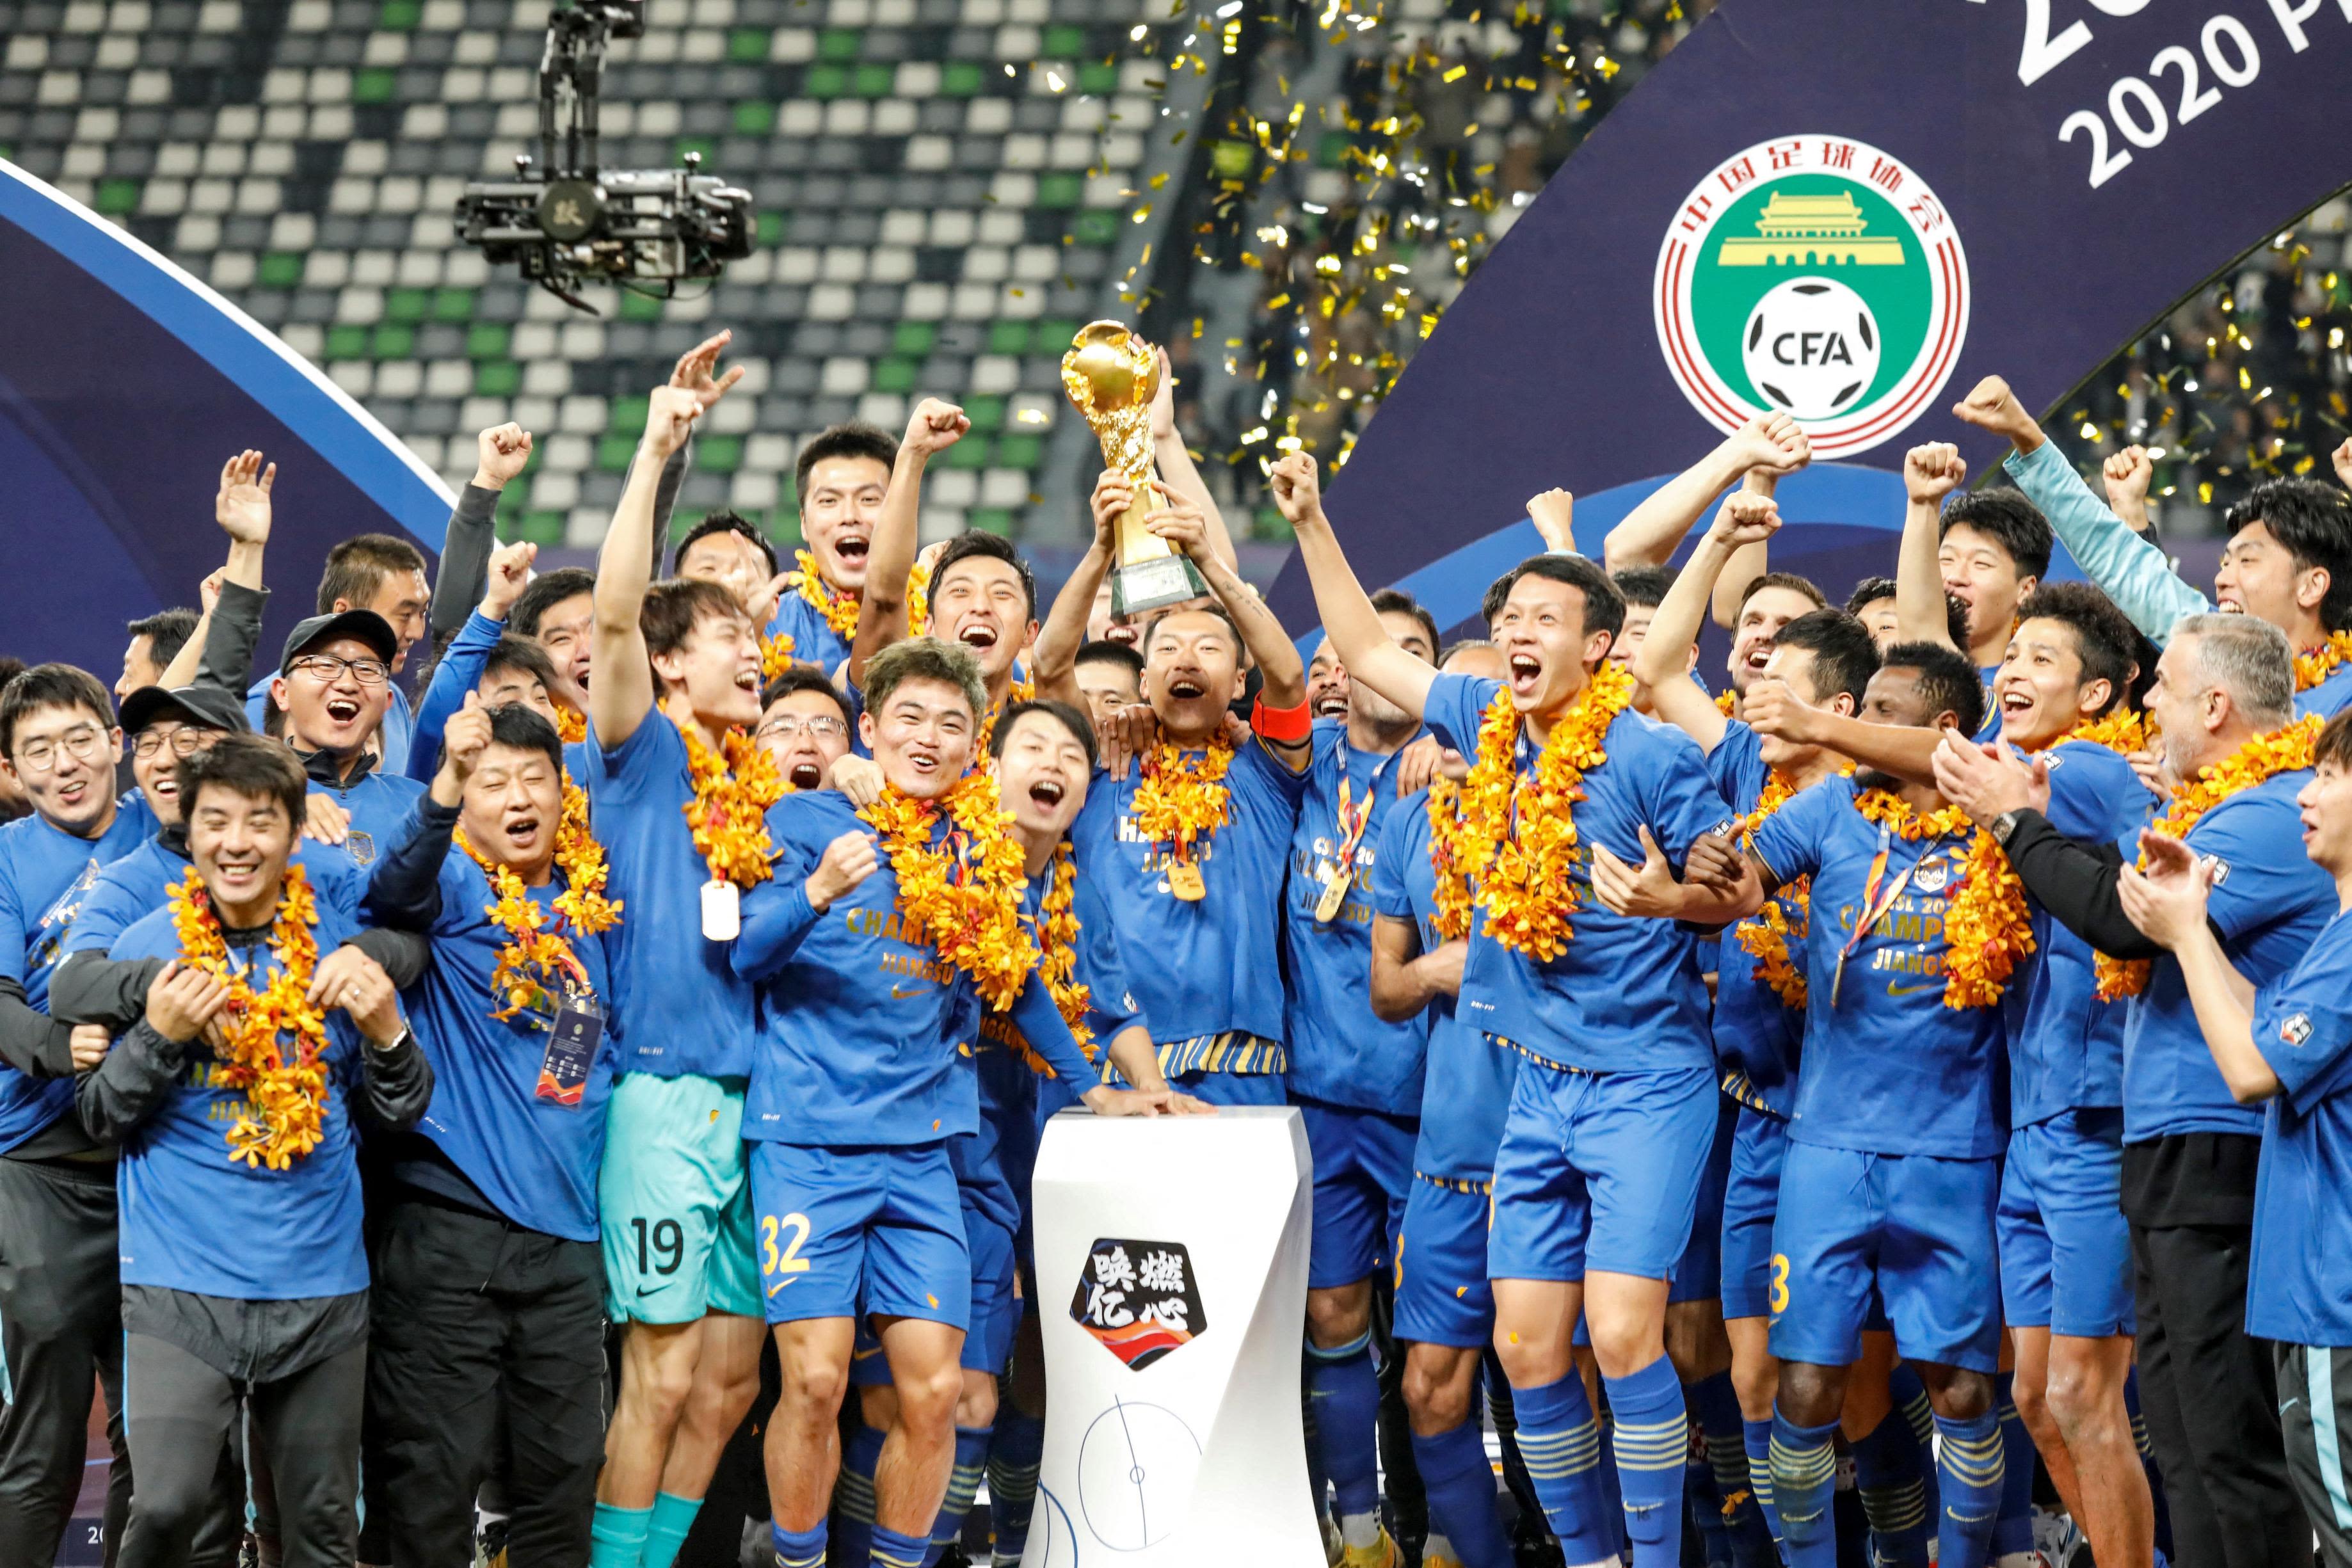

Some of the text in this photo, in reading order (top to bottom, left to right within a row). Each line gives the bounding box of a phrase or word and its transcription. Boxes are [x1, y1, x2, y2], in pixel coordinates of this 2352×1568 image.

[2058, 14, 2260, 189] 2020
[1681, 141, 1943, 232] 中国足球协会
[1772, 332, 1853, 366] CFA
[879, 952, 955, 985] JIANGSU
[631, 1218, 684, 1275] 19
[762, 1213, 810, 1276] 32
[1769, 1253, 1789, 1314] 3
